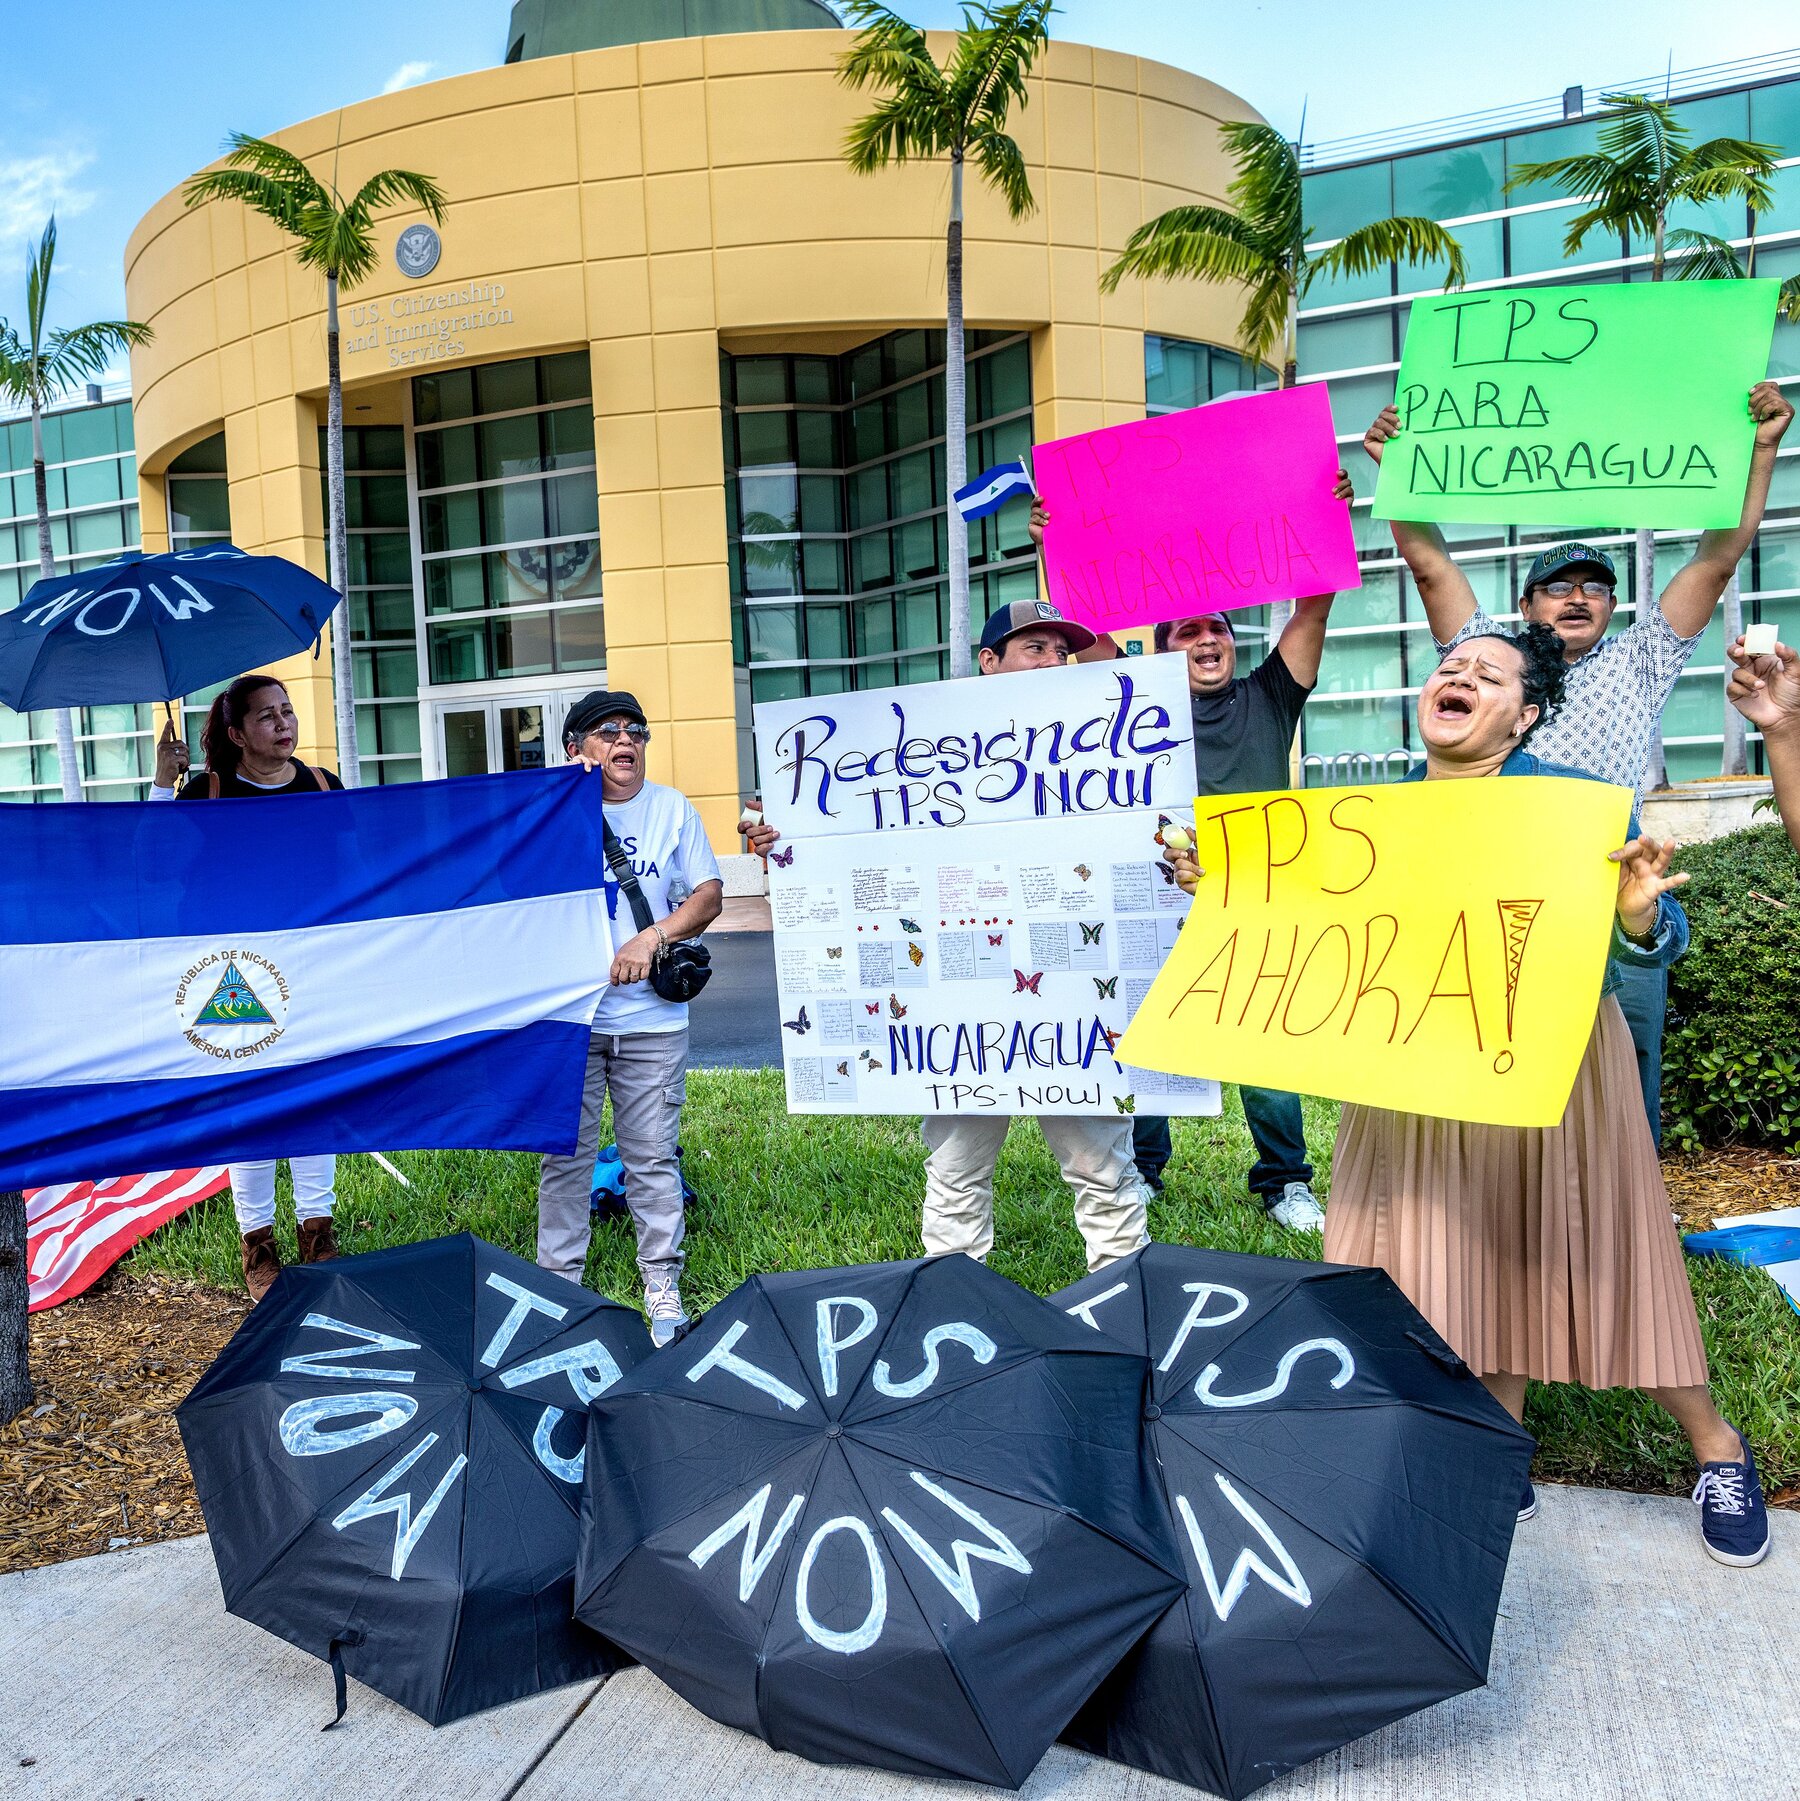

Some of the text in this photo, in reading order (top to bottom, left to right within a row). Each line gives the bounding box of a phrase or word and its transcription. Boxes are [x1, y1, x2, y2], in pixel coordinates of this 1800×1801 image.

[346, 308, 514, 353] and Immigration
[350, 281, 505, 328] U.S. Citizenship
[1434, 298, 1599, 366] TPS
[388, 340, 465, 367] Services
[1402, 381, 1550, 431] PARA
[1052, 422, 1183, 498] TPS
[1409, 442, 1718, 493] NICARAGUA
[1082, 506, 1120, 535] 4
[1060, 514, 1318, 623] NICARAGUA
[22, 575, 215, 636] NOW
[775, 671, 1193, 818] Redesignate
[1034, 755, 1171, 816] NOW
[1206, 795, 1376, 908] TPS
[175, 950, 290, 1005] REPÚBLICA DE NICARAGUA
[1168, 899, 1544, 1075] AHORA!
[183, 1027, 285, 1060] AMÉRICA CENTRAL
[889, 1015, 1123, 1076] NICARAGUA
[685, 1296, 998, 1411] TPS
[279, 1312, 469, 1581] NOW
[688, 1470, 1032, 1655] NOW
